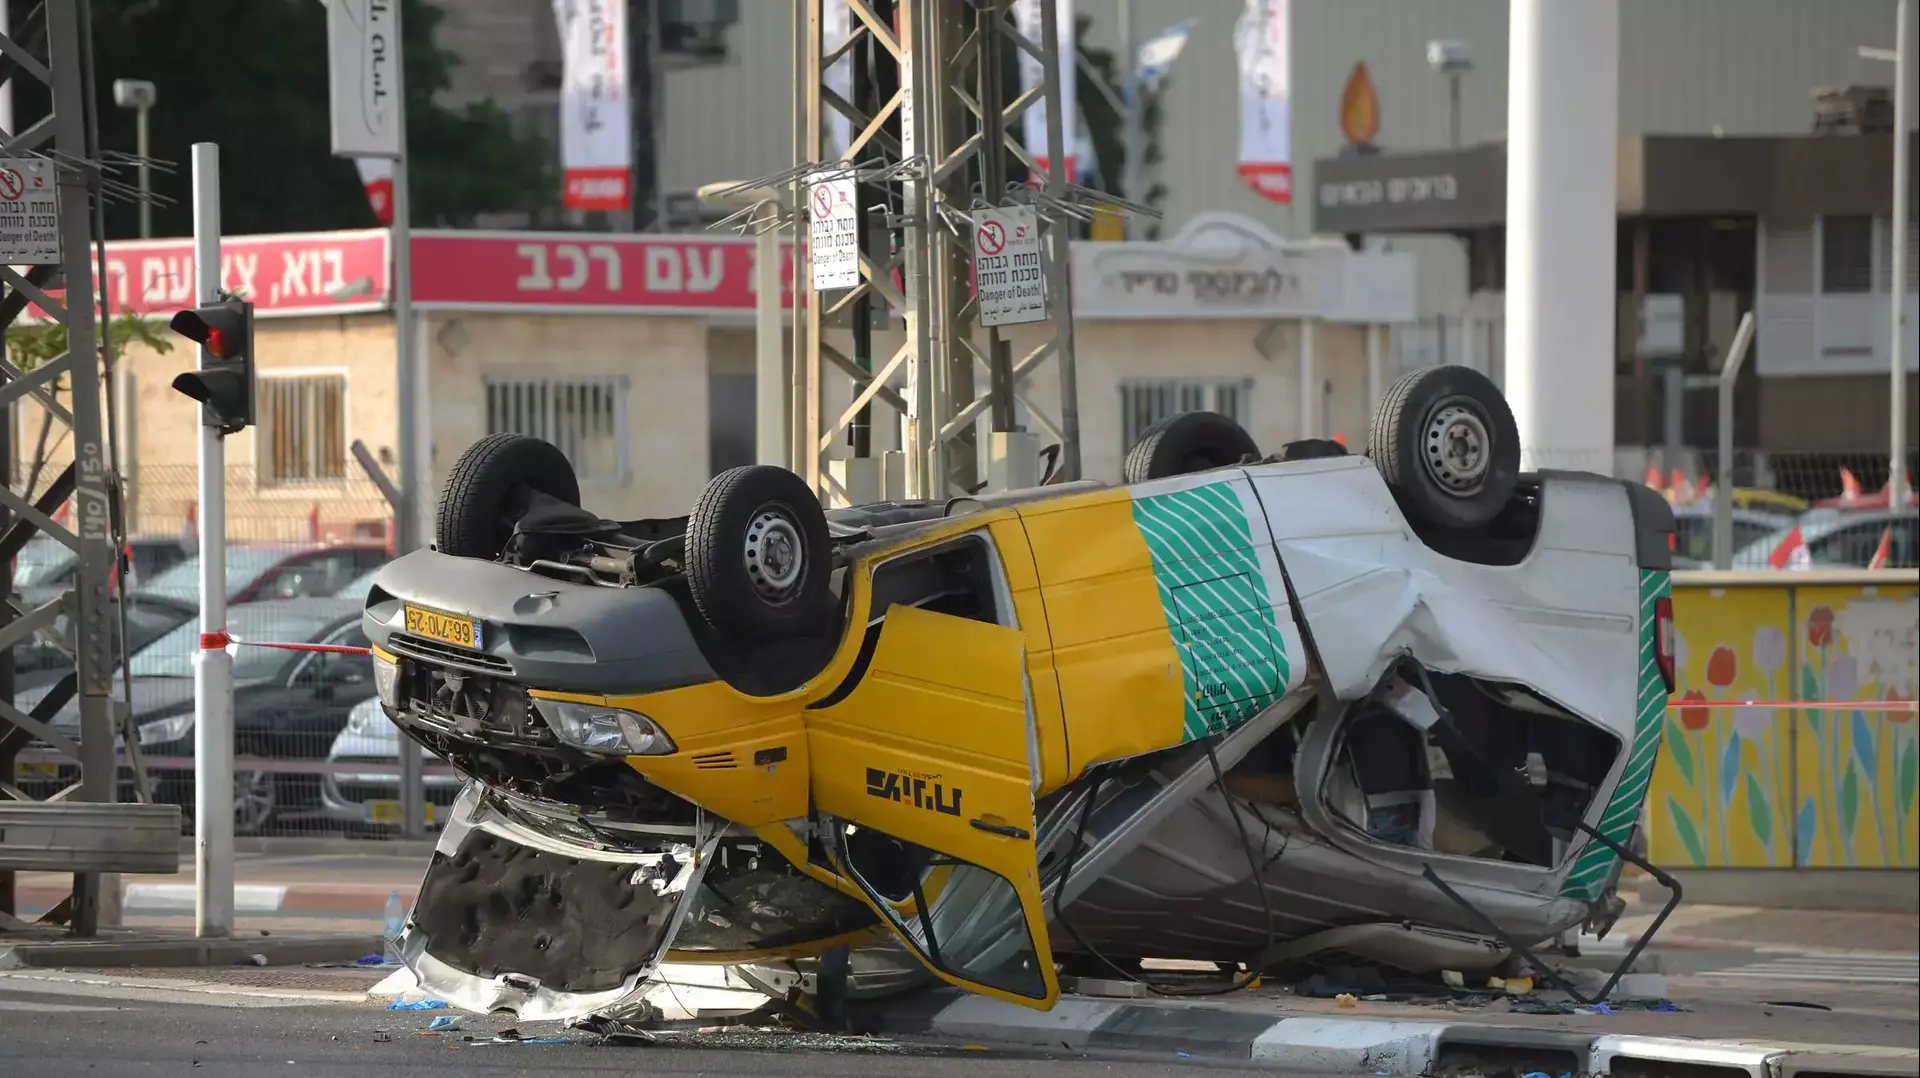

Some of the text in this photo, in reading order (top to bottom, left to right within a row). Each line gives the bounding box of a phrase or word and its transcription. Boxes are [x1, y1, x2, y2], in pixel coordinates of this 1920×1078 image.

[31, 201, 54, 213] מתח
[29, 215, 55, 228] סכנת
[837, 217, 854, 231] מתח
[836, 232, 854, 247] סכנת
[516, 244, 622, 291] רכב
[645, 246, 724, 291] עם
[814, 253, 831, 267] Danger
[978, 253, 1038, 270] מתח גבוה!
[143, 255, 192, 303] עם
[978, 268, 1038, 286] סכנת מוות!
[980, 283, 1041, 303] Danger of Death!
